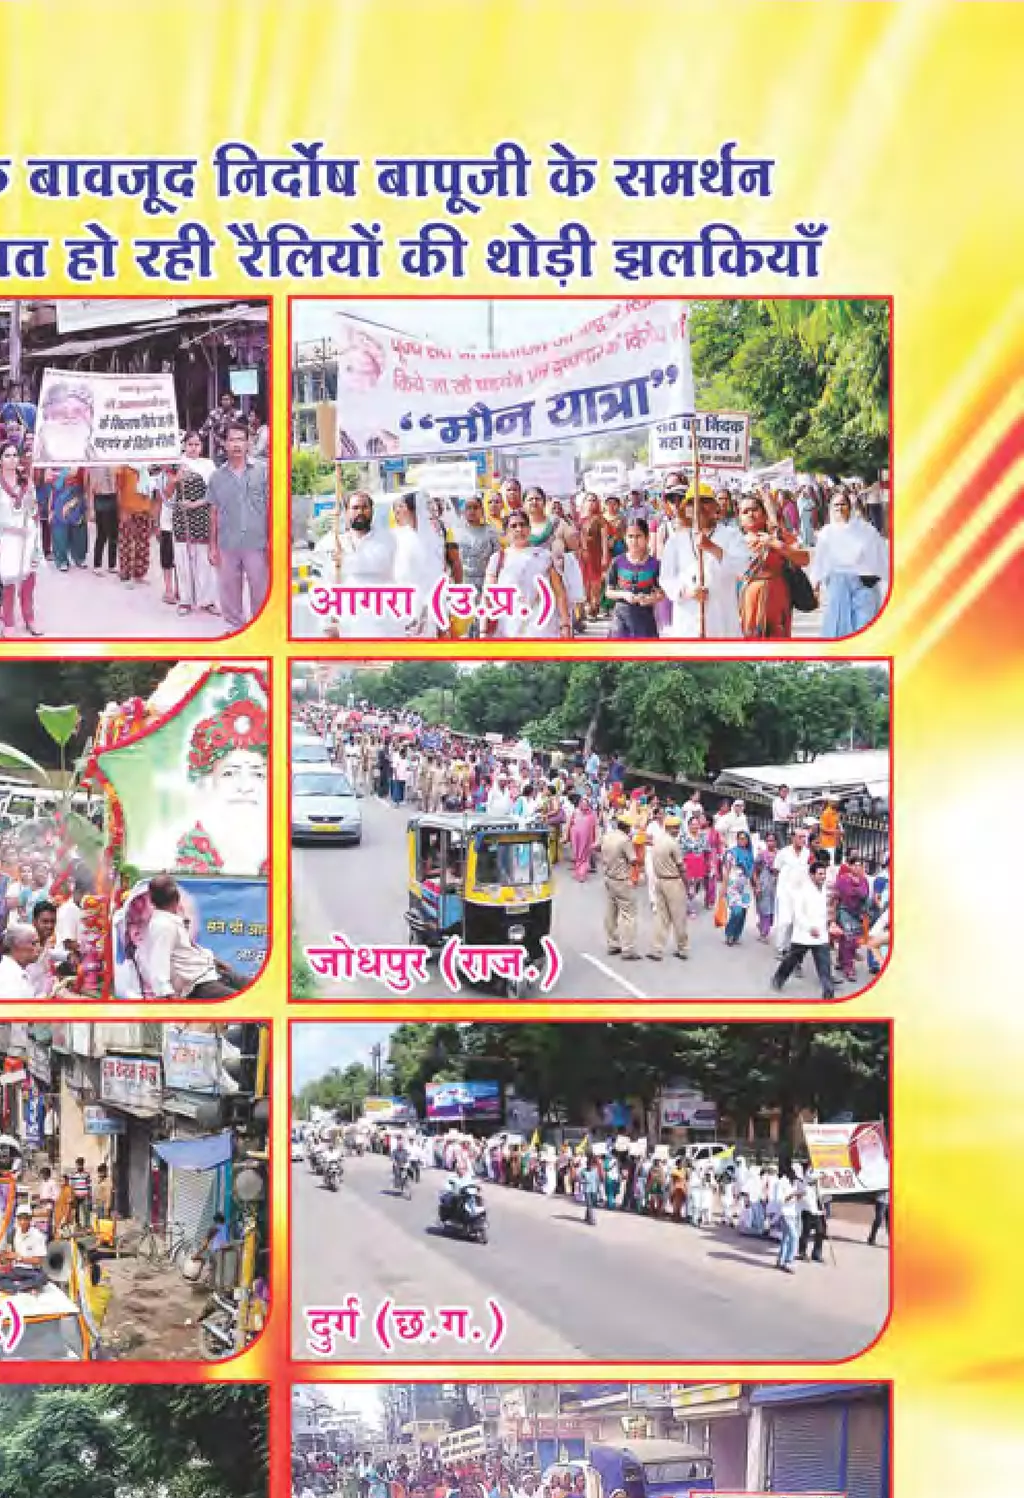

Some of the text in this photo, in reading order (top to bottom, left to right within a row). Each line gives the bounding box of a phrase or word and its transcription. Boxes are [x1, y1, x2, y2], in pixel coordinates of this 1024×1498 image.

[29, 161, 197, 212] बावजूद
[214, 143, 358, 197] निर्दोष
[376, 143, 531, 212] बापूजी
[549, 143, 597, 197] के
[615, 143, 773, 197] समर्थन
[65, 224, 118, 280] हो
[135, 223, 214, 280] रही
[228, 223, 382, 277] रैलियों
[400, 223, 467, 277] की
[488, 223, 595, 287] थोड़ी
[614, 221, 828, 280] झलकियाँ
